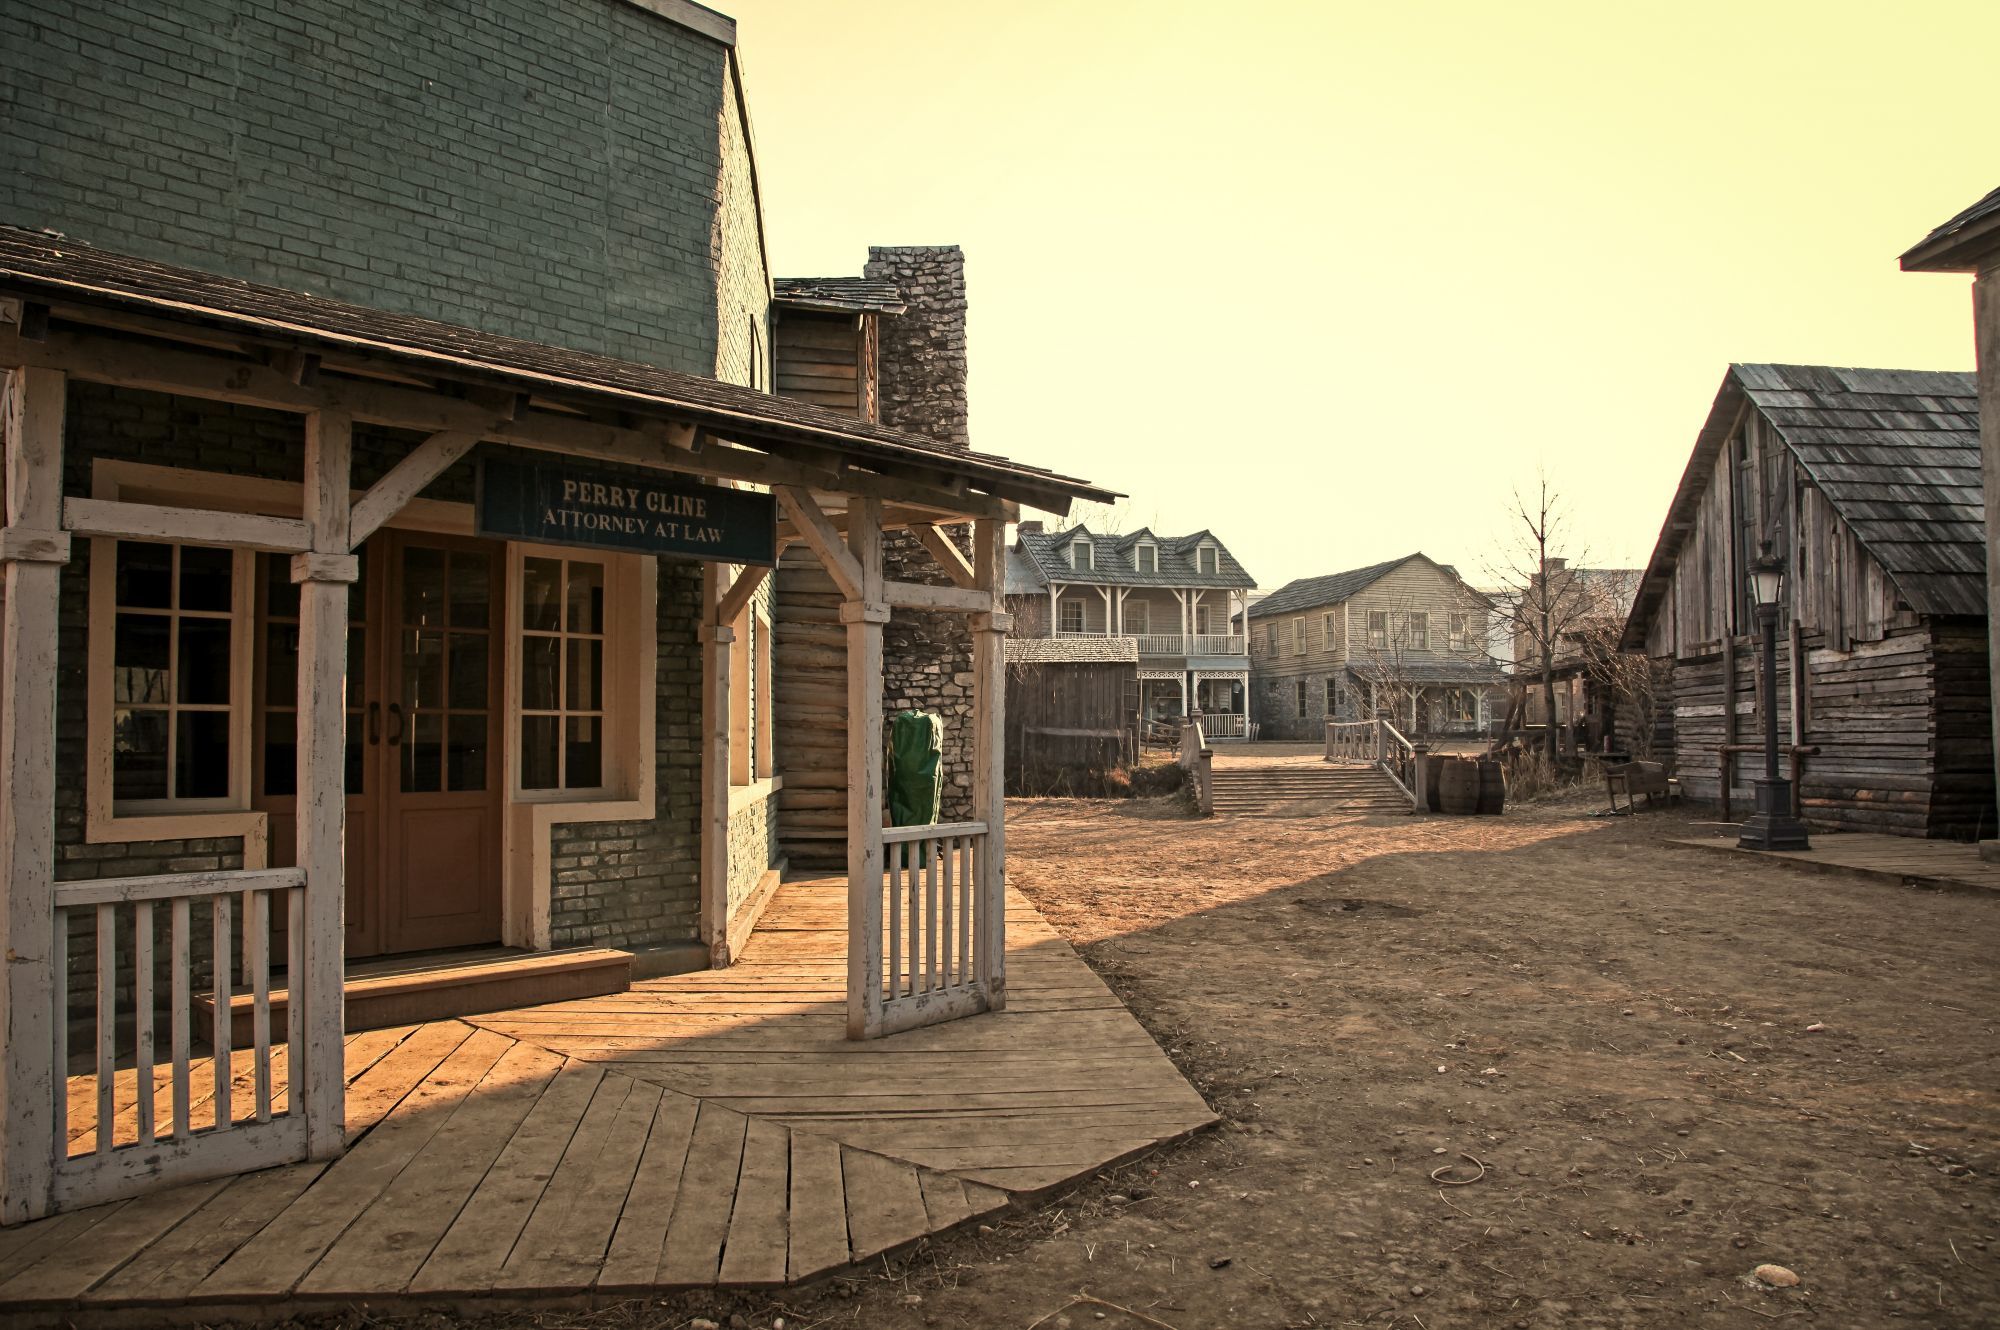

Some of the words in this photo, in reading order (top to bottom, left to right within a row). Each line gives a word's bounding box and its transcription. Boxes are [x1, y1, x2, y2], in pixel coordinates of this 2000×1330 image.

[563, 480, 641, 509] PERRY
[647, 491, 706, 518] CLINE
[543, 509, 649, 533] ATTORNEY
[654, 522, 678, 538] AT
[685, 525, 724, 543] LAW
